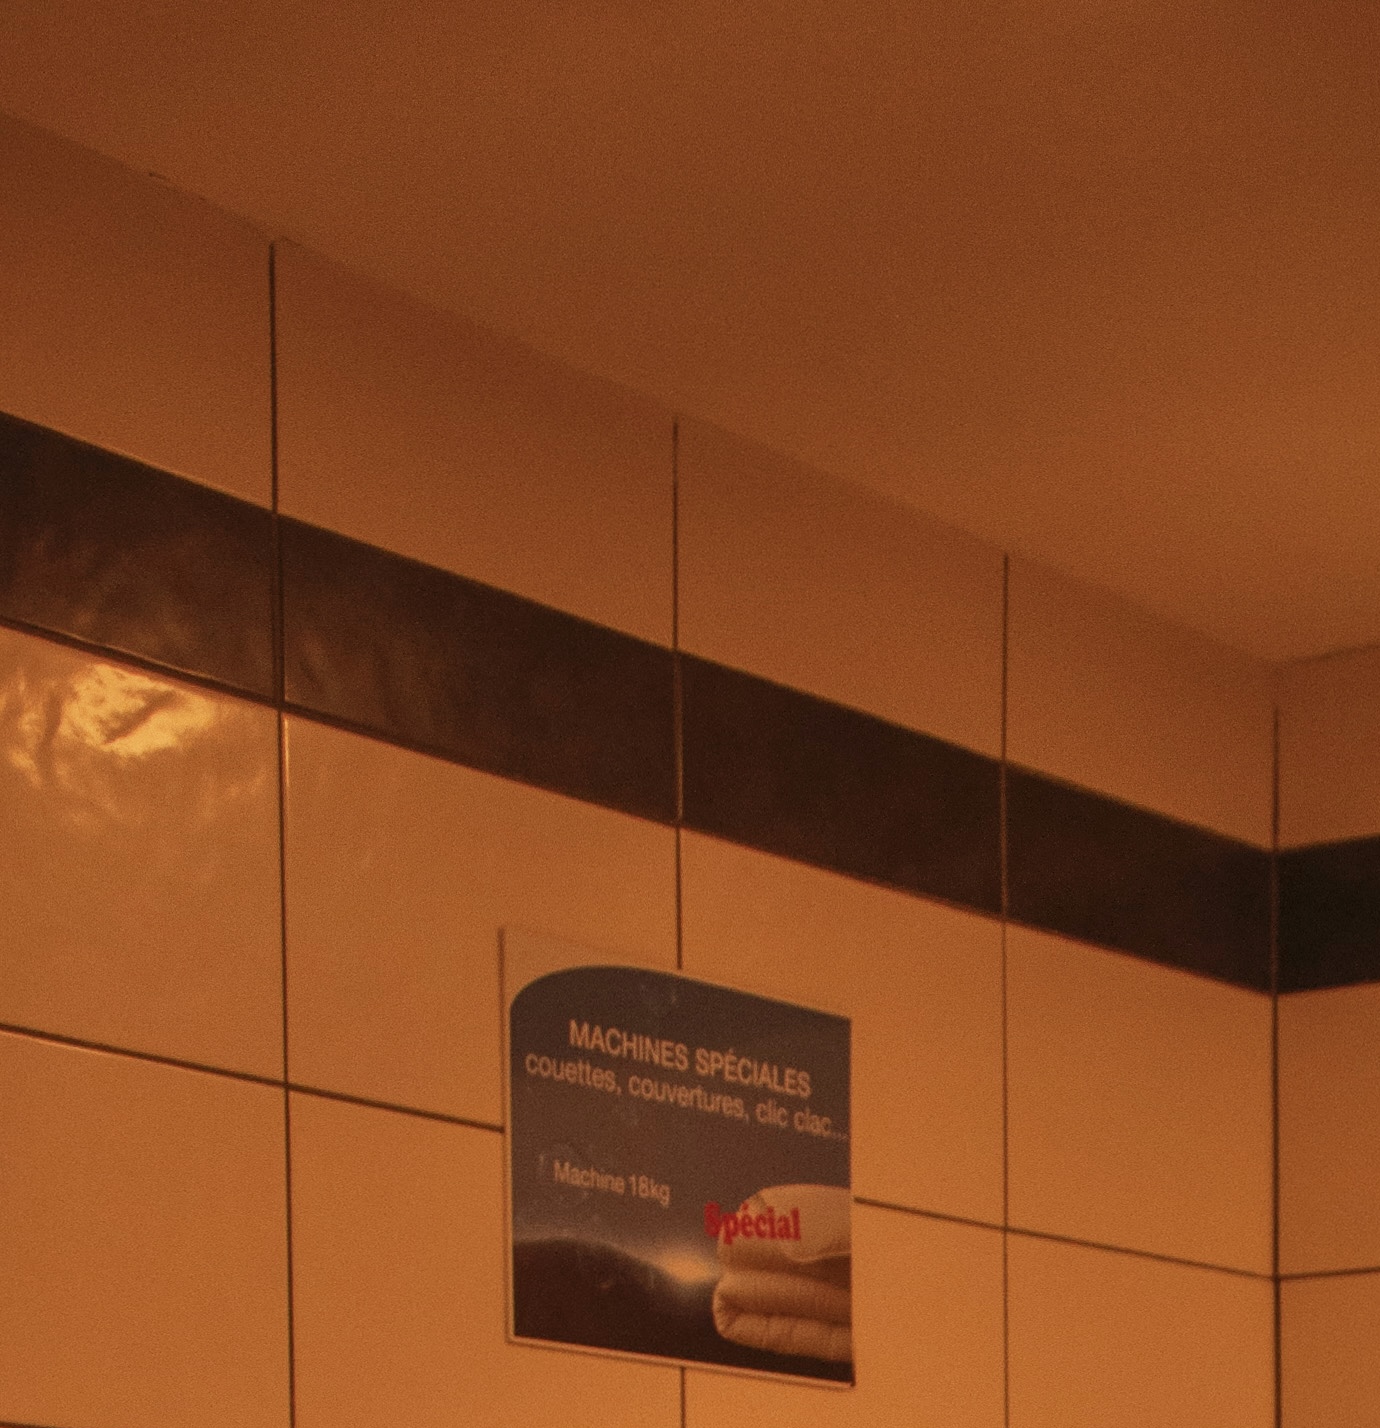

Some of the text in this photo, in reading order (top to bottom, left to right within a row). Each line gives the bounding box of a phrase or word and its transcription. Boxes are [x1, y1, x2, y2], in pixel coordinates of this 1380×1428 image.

[568, 1019, 813, 1098] MACHINES SPÉCIALES
[525, 1053, 623, 1096] couettes,
[628, 1075, 749, 1123] couvertures,
[755, 1100, 788, 1128] clic
[553, 1160, 671, 1209] Machine 18kg
[704, 1201, 801, 1245] Spécial
